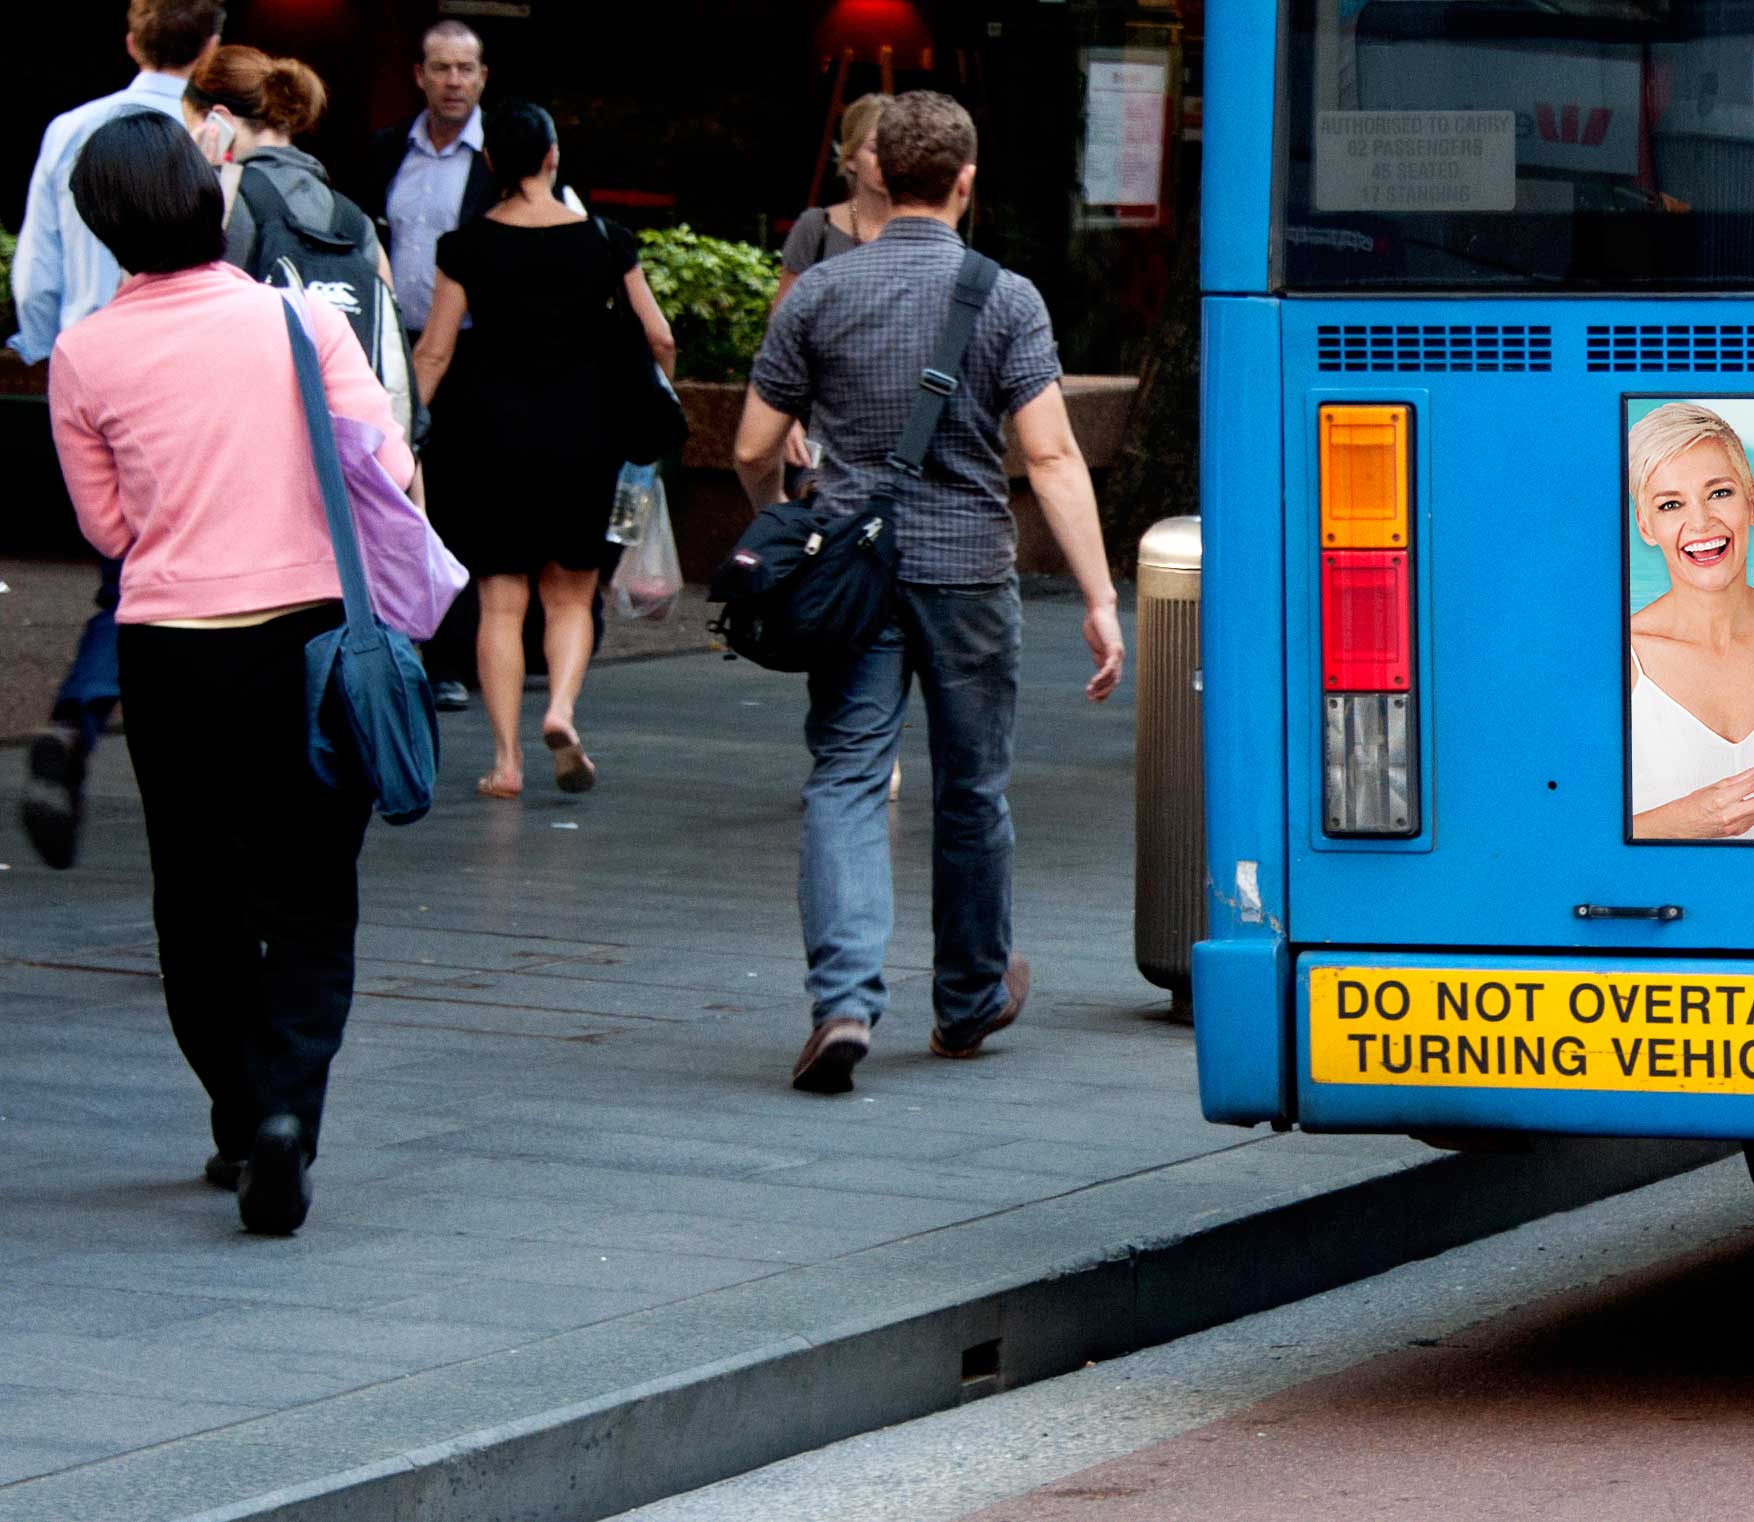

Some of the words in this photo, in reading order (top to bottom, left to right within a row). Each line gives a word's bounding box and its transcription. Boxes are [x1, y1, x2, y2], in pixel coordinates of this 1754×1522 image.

[1429, 117, 1449, 134] TO
[1455, 116, 1510, 133] CARRY
[1373, 138, 1484, 157] PASSENGERS
[1397, 161, 1460, 179] SEATED
[1386, 185, 1471, 204] STANDING
[1337, 980, 1410, 1021] DO
[1438, 982, 1545, 1022] NOT
[1347, 1034, 1587, 1076] TURNING
